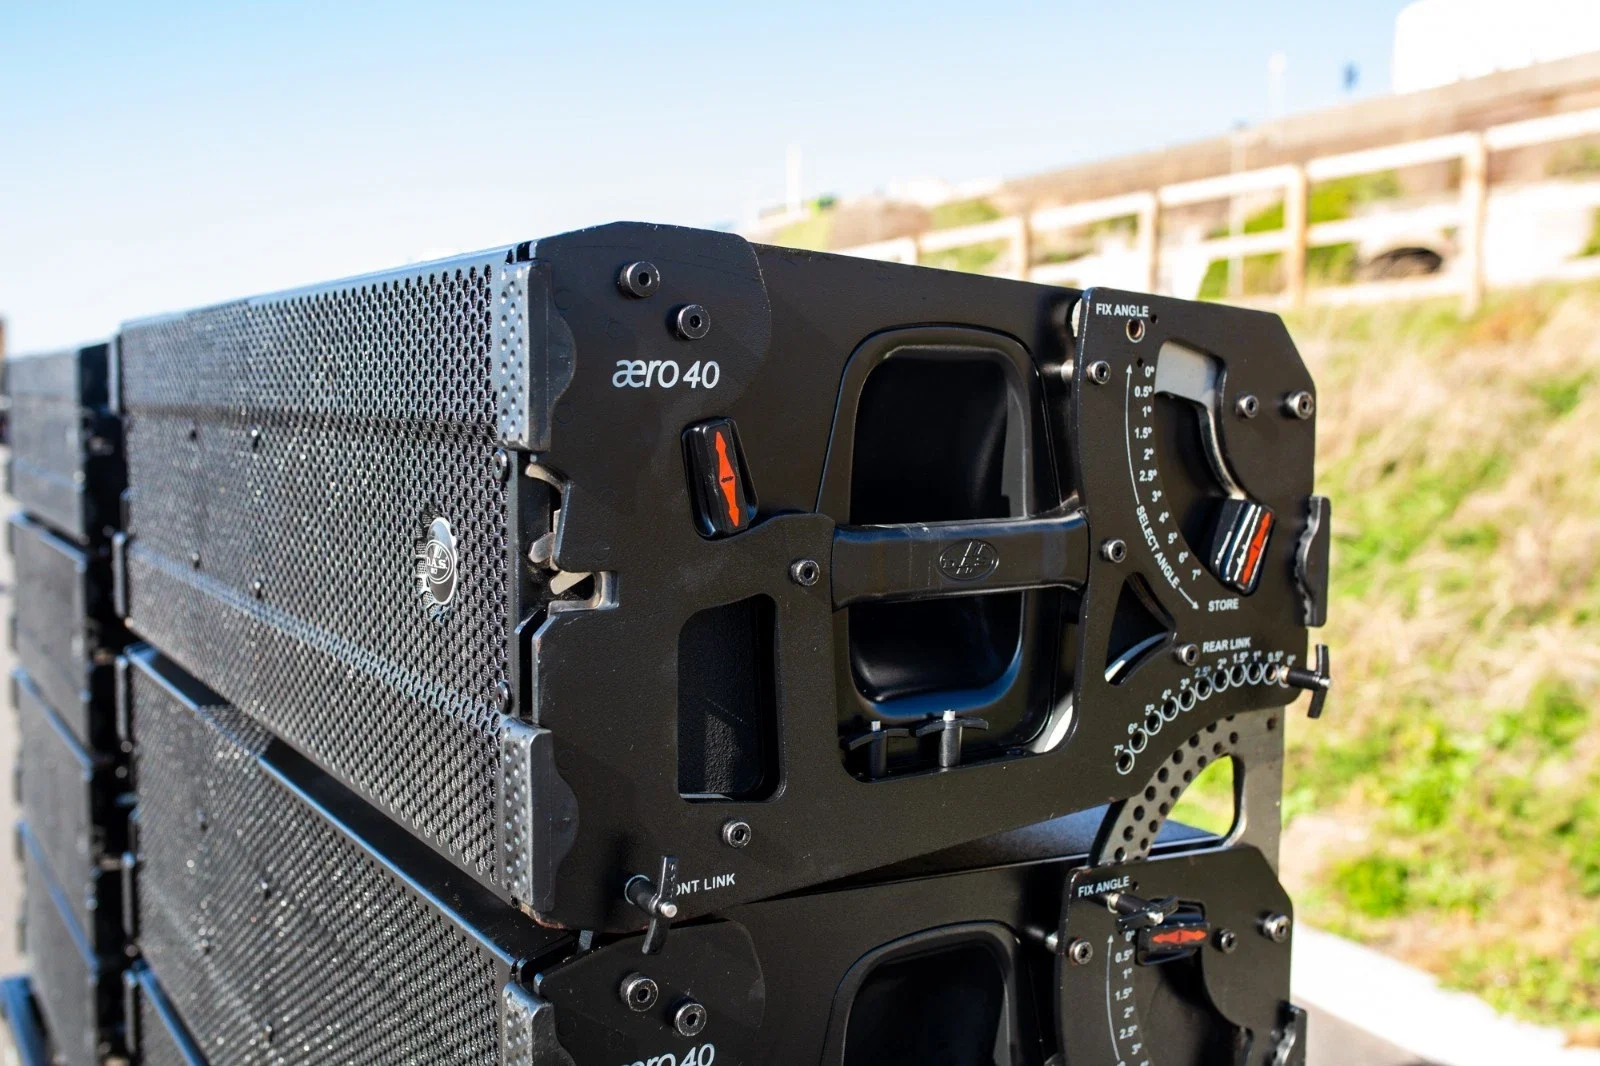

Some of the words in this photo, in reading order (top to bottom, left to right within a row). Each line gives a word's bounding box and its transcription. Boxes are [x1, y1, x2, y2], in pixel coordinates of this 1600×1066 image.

[1096, 303, 1112, 316] FIX
[1114, 304, 1149, 318] ANGLE
[682, 360, 720, 389] 40
[1136, 505, 1160, 552] SELECT
[1154, 551, 1180, 589] ANGLE
[1207, 597, 1240, 612] STORE
[1202, 638, 1229, 654] REAR
[1229, 636, 1252, 651] LINK
[703, 872, 736, 891] LINK
[1077, 885, 1094, 898] FIX
[1096, 876, 1131, 894] ANGLE
